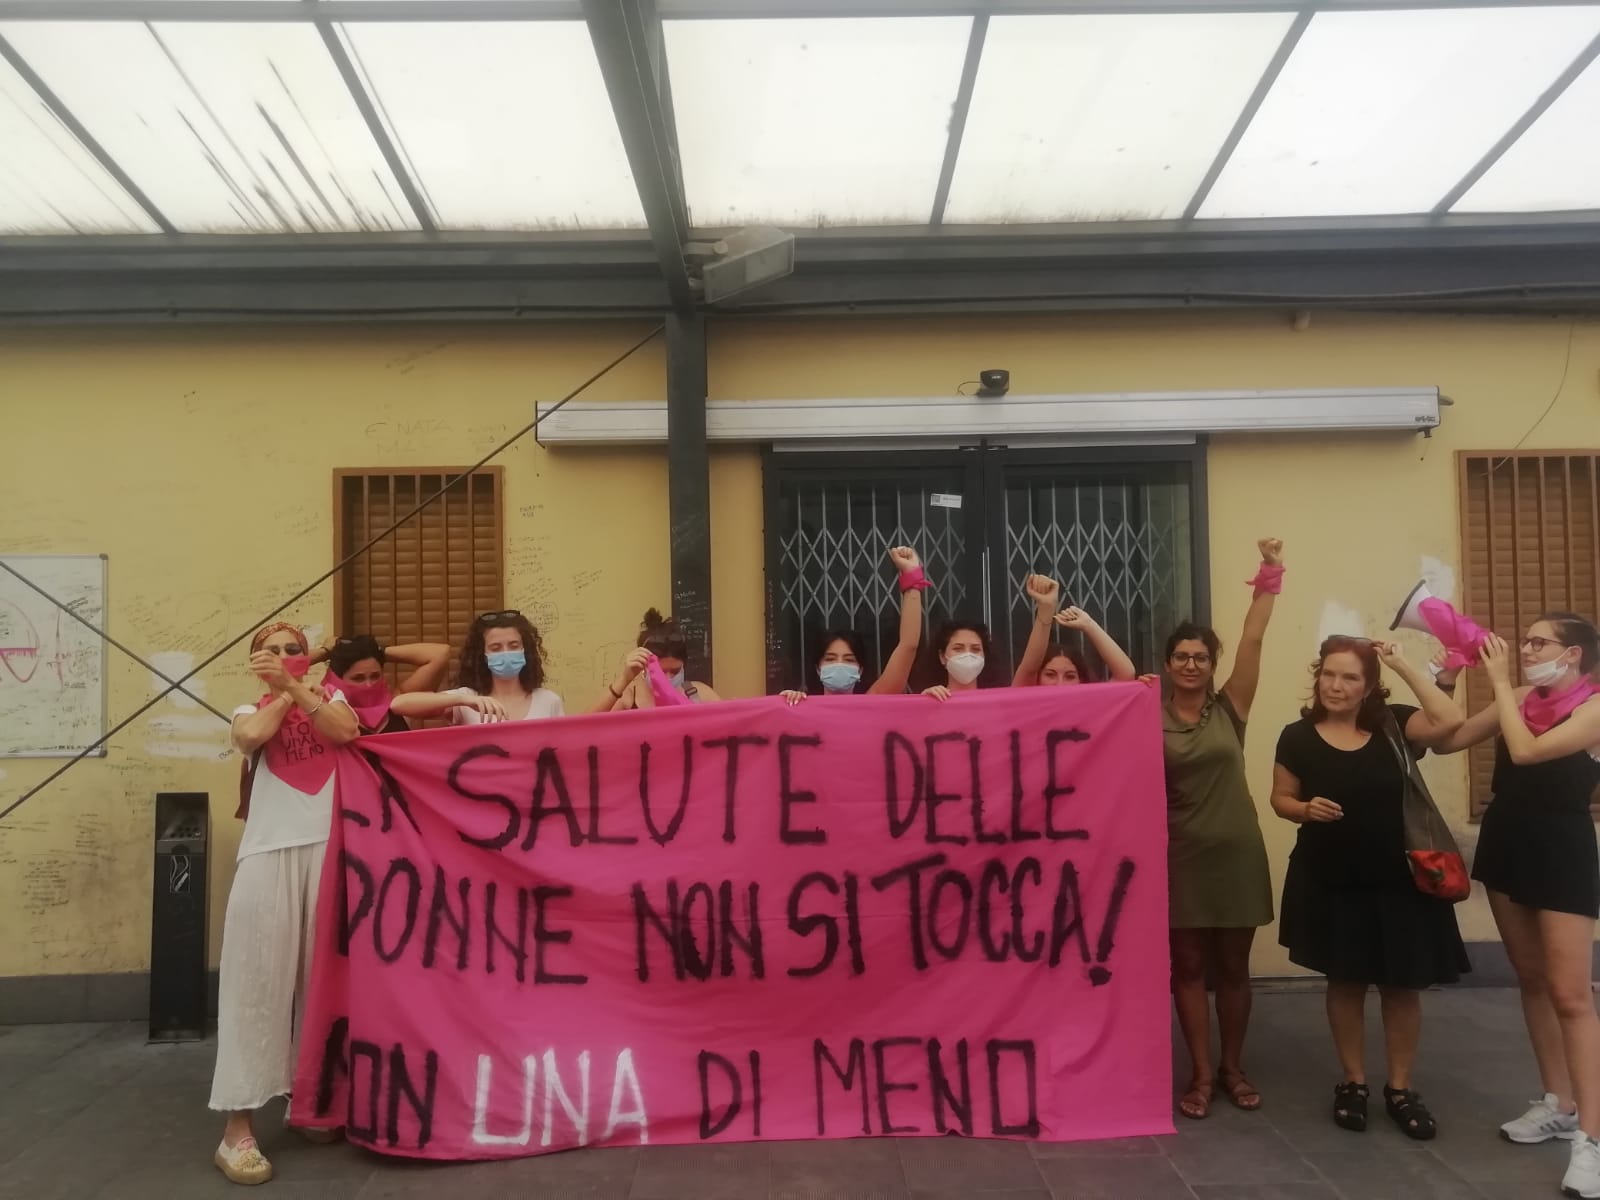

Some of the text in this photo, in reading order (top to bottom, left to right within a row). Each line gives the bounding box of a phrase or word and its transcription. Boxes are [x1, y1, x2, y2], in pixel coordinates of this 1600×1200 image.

[447, 734, 826, 851] SALUTE
[884, 728, 1090, 845] DELLE
[338, 848, 1135, 986] DONNE NON SI TOCCA!
[473, 1047, 648, 1147] UNA
[699, 1049, 762, 1138] DI
[813, 1036, 1041, 1137] MENO
